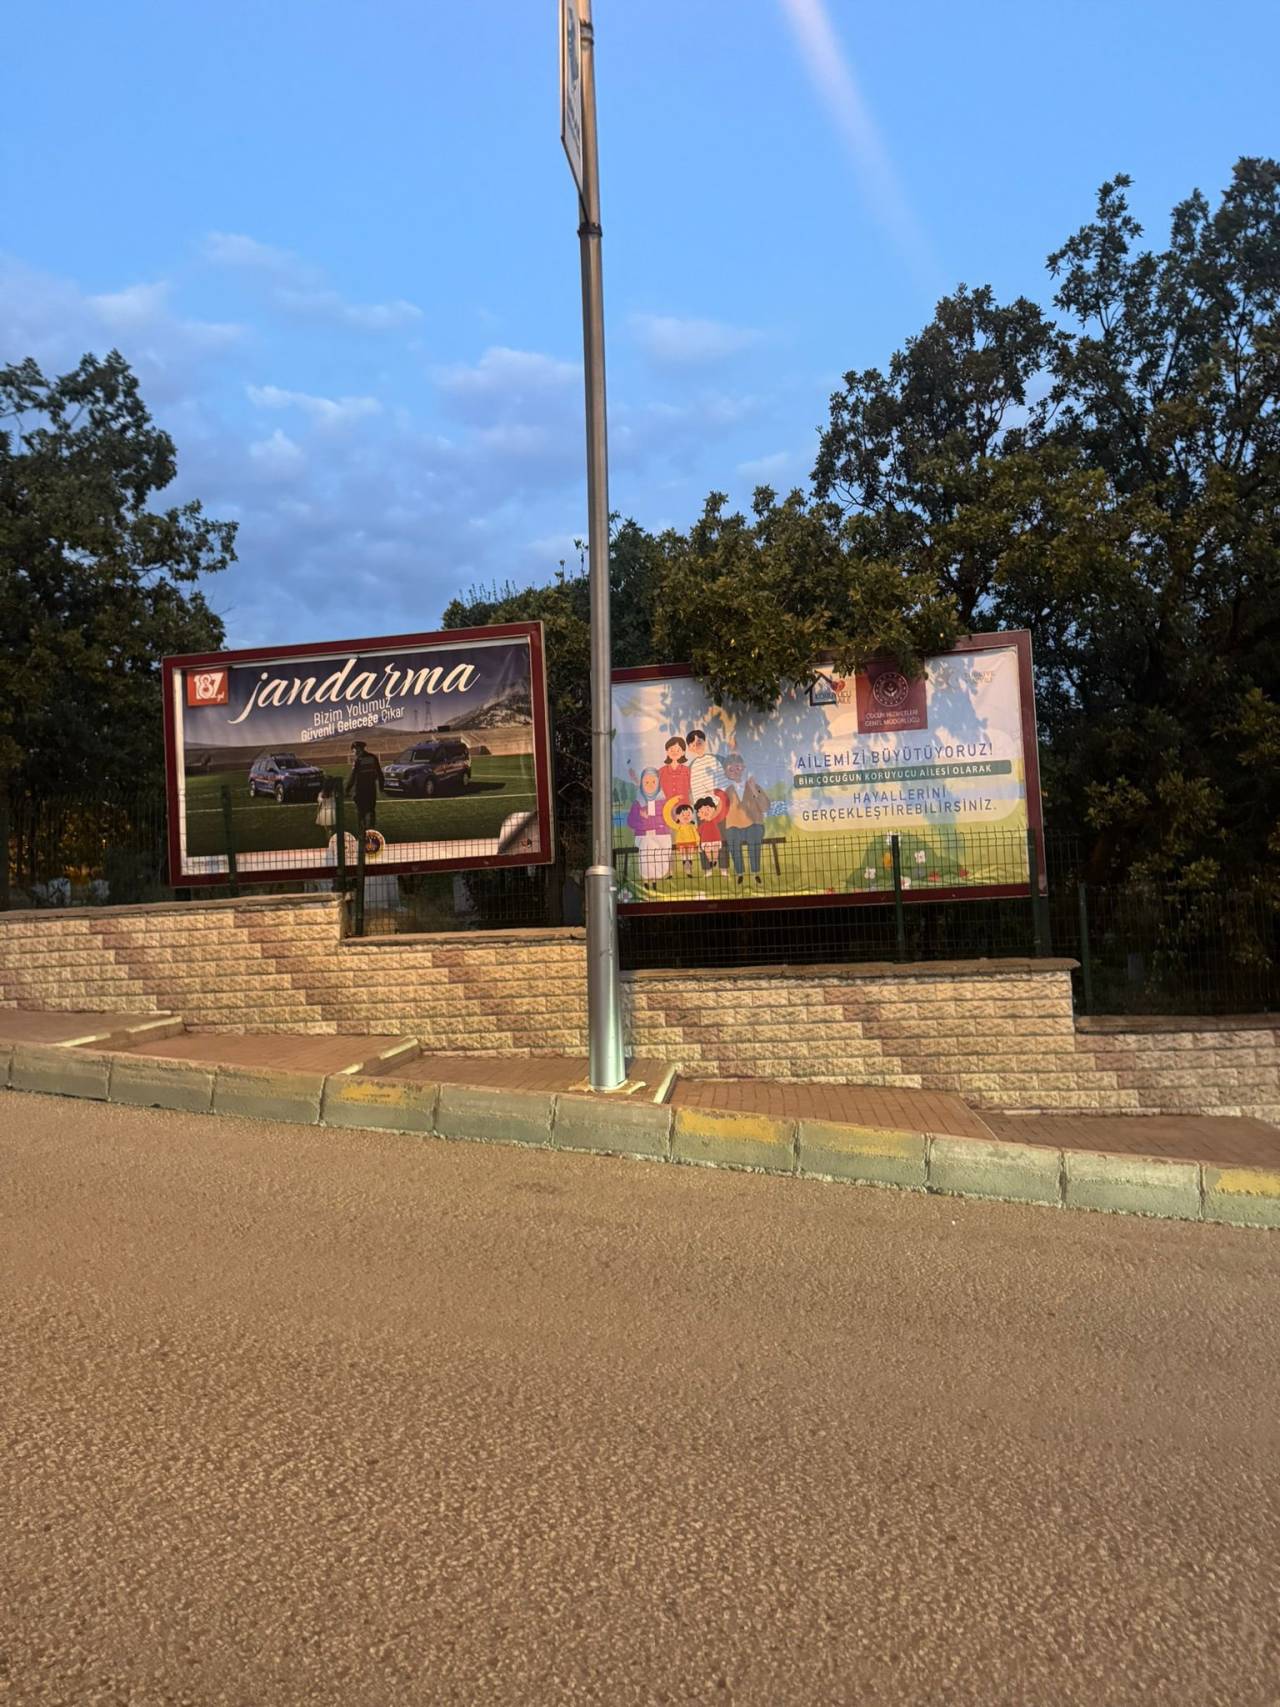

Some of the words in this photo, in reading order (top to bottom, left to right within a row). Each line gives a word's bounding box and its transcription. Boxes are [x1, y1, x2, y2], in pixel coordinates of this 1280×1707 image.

[228, 658, 481, 724] jandarma
[313, 708, 343, 727] Bizim
[346, 697, 391, 718] Yolumuz
[301, 722, 335, 742] Güvenli
[337, 713, 379, 732] Geleceğe
[797, 752, 866, 769] AİLEMİZİ
[871, 742, 993, 765] BÜYÜTÜYORUZ!
[798, 776, 814, 785] BİR
[816, 773, 862, 786] ÇOCUĞUN
[864, 770, 918, 781] KORUYUCU
[919, 767, 951, 777] AİLESİ
[953, 764, 992, 775] OLARAK
[852, 786, 947, 804] HAYALLERİNİ
[801, 798, 998, 822] GERÇEKLEŞTİREBİLİRSİNİZ.
